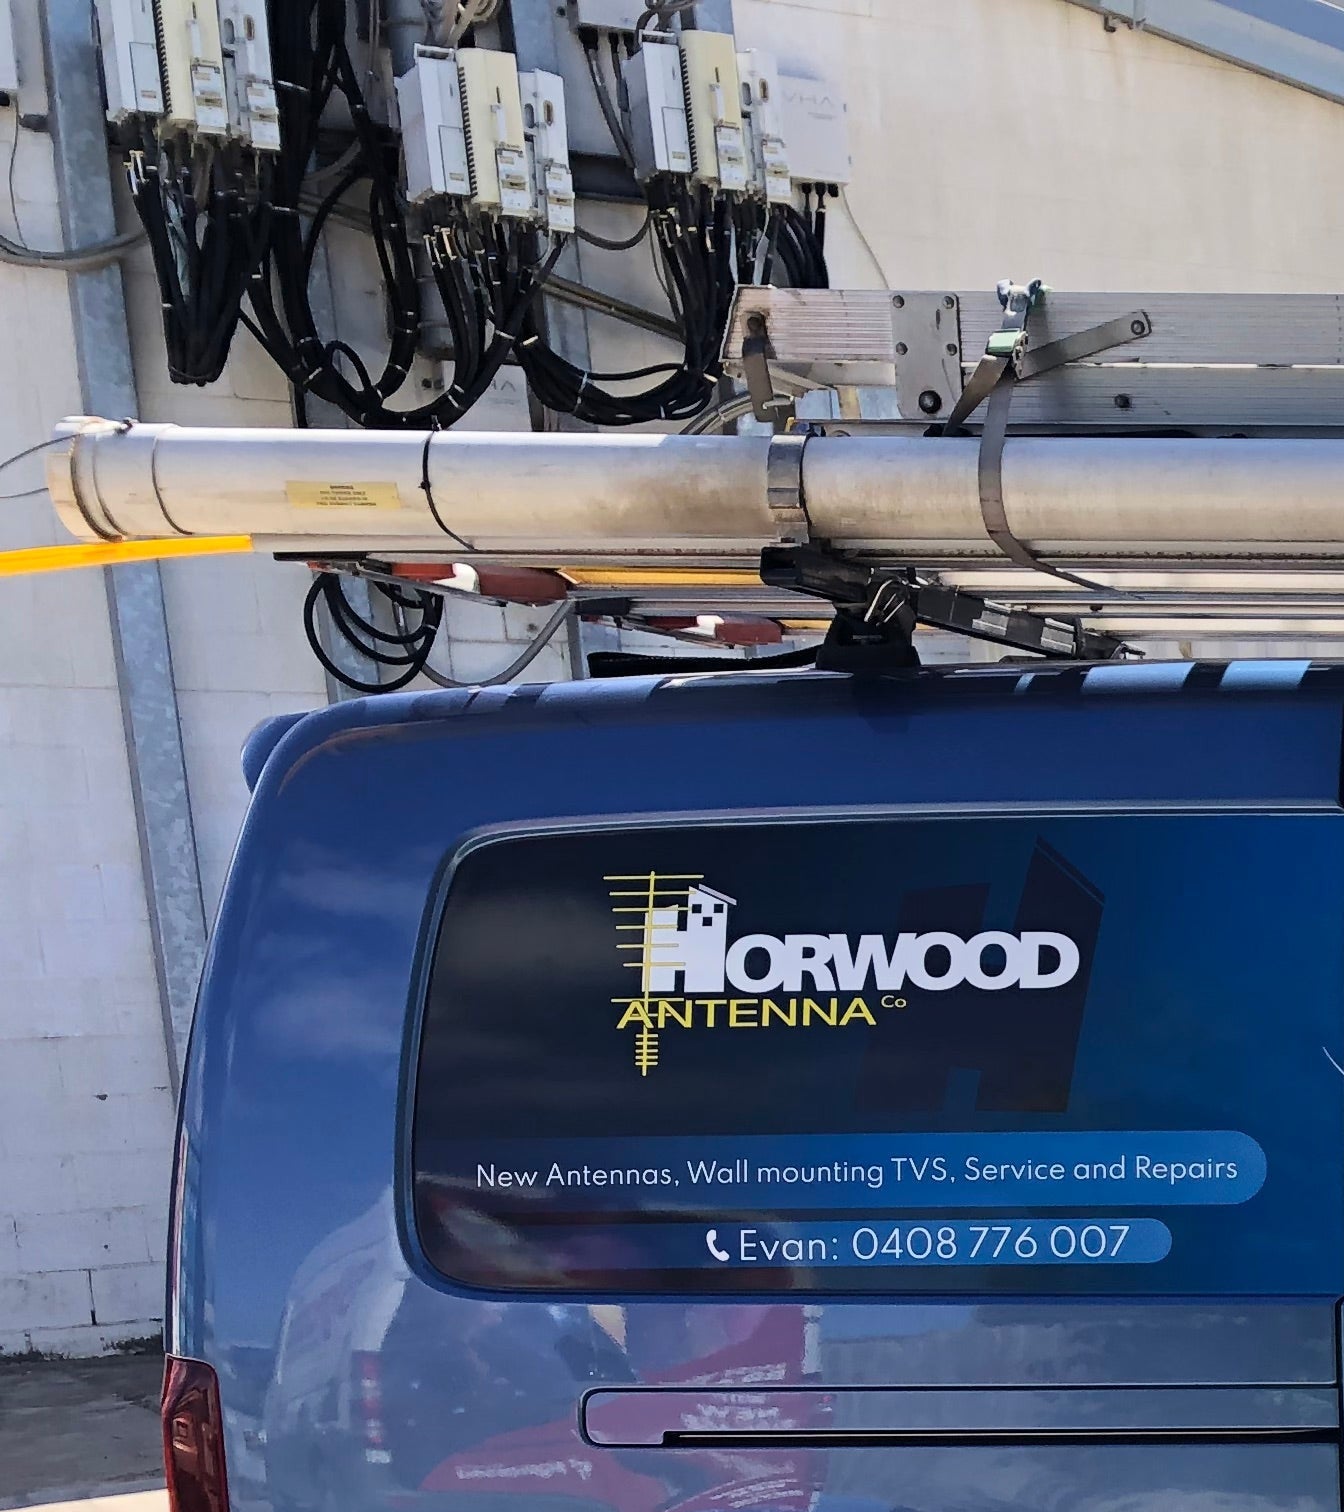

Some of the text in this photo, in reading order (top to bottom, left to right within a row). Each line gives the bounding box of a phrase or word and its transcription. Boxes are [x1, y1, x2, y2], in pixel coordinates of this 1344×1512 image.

[642, 885, 1080, 993] HORWOOD
[616, 995, 908, 1030] ANTENNA Co
[477, 1155, 1238, 1188] New Antennas, Wall mounting TVS, Service and Repairs
[740, 1224, 1130, 1262] Evan: 0408 776 007
